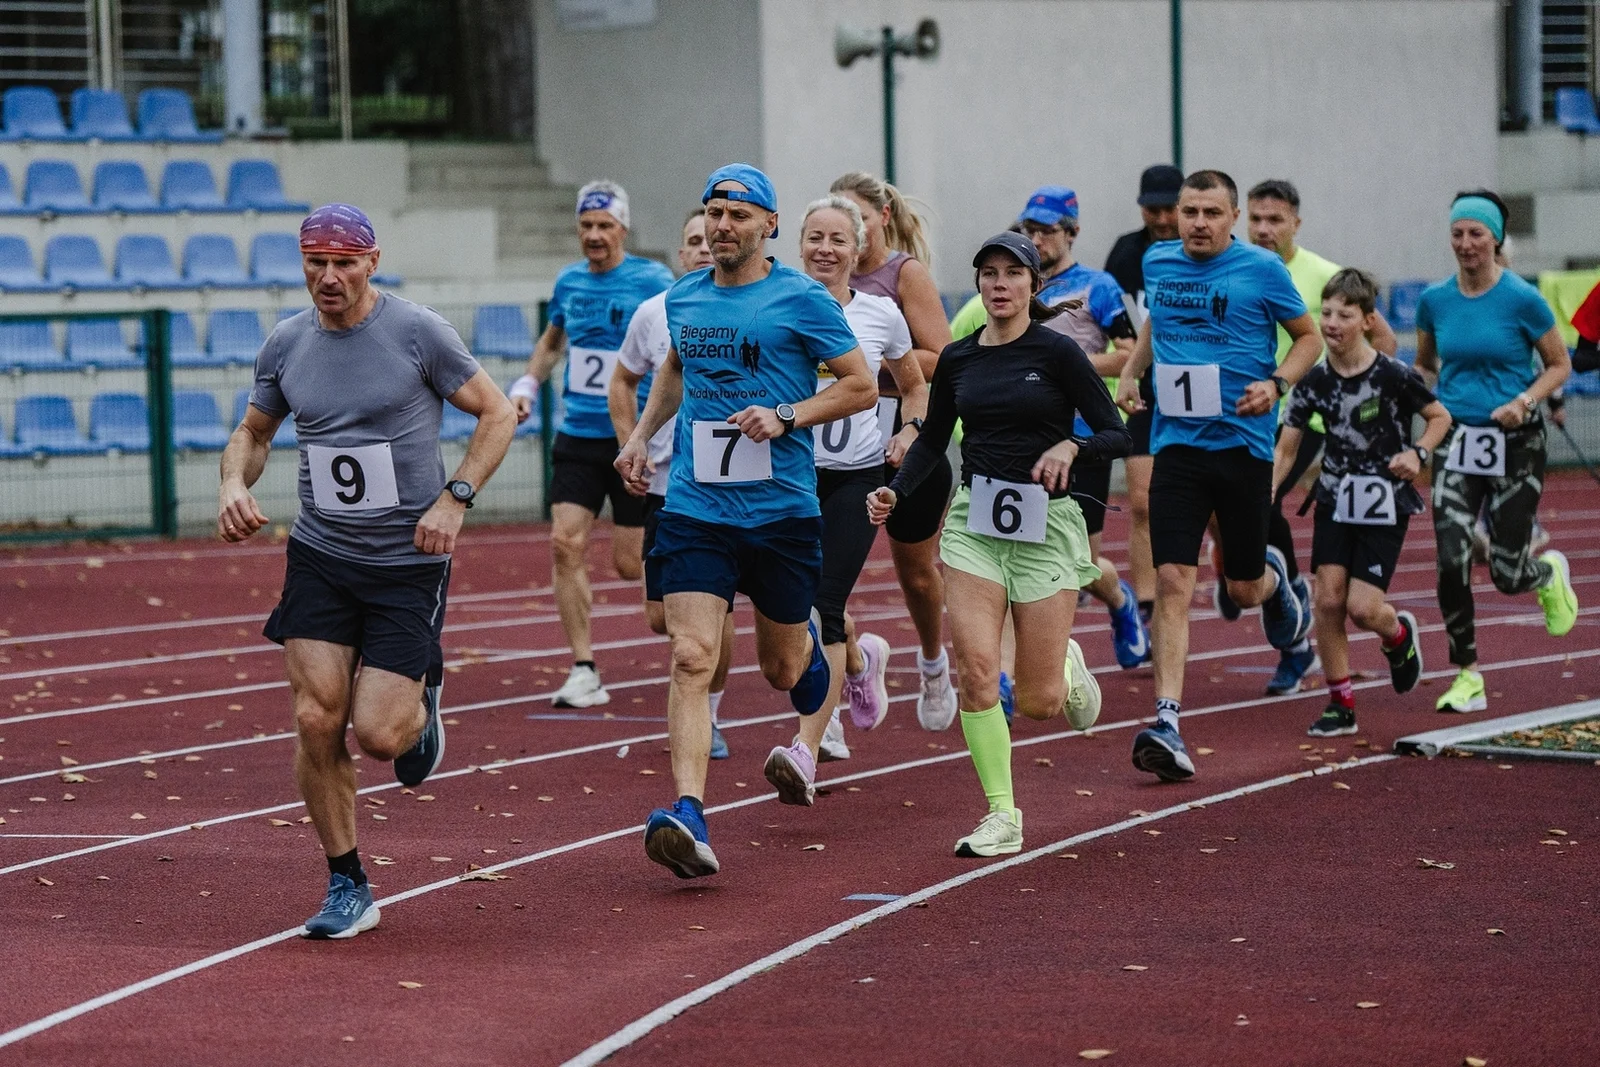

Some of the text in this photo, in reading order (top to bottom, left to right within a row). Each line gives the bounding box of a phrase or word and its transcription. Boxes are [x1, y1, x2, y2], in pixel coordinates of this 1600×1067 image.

[1154, 292, 1207, 309] Razem
[1157, 280, 1212, 295] Biegamy
[680, 325, 739, 342] Biegamy
[680, 341, 736, 359] Razem
[585, 355, 604, 389] 2
[1174, 371, 1192, 412] 1
[712, 429, 742, 476] 7
[1456, 432, 1498, 469] 13
[1343, 481, 1389, 519] 12
